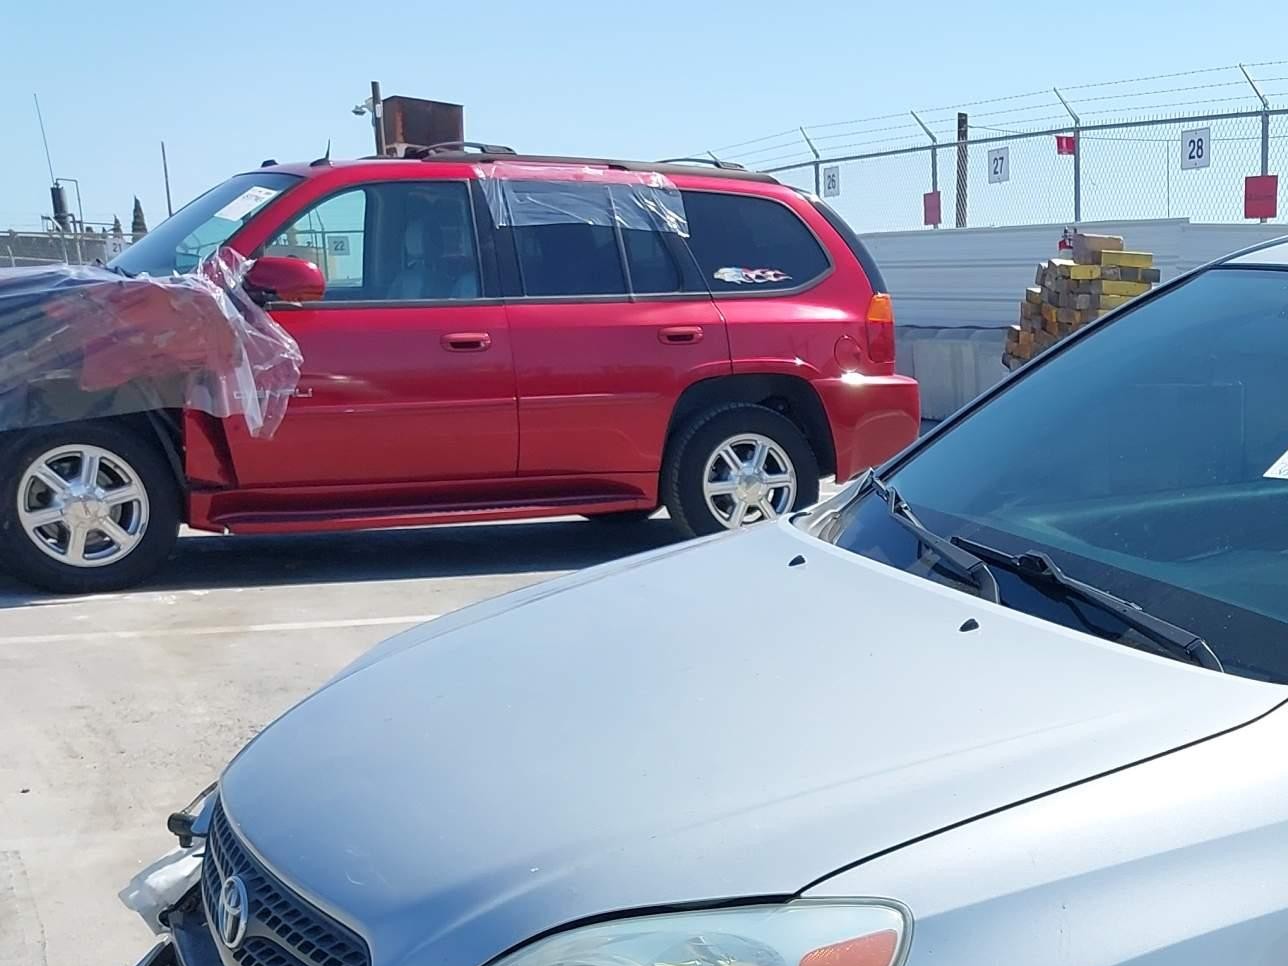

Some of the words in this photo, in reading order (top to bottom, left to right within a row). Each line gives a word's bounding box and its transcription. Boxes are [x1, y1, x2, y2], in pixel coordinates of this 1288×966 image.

[1187, 137, 1205, 161] 28
[992, 156, 1005, 176] 27
[827, 172, 837, 191] 26
[332, 240, 345, 251] 22
